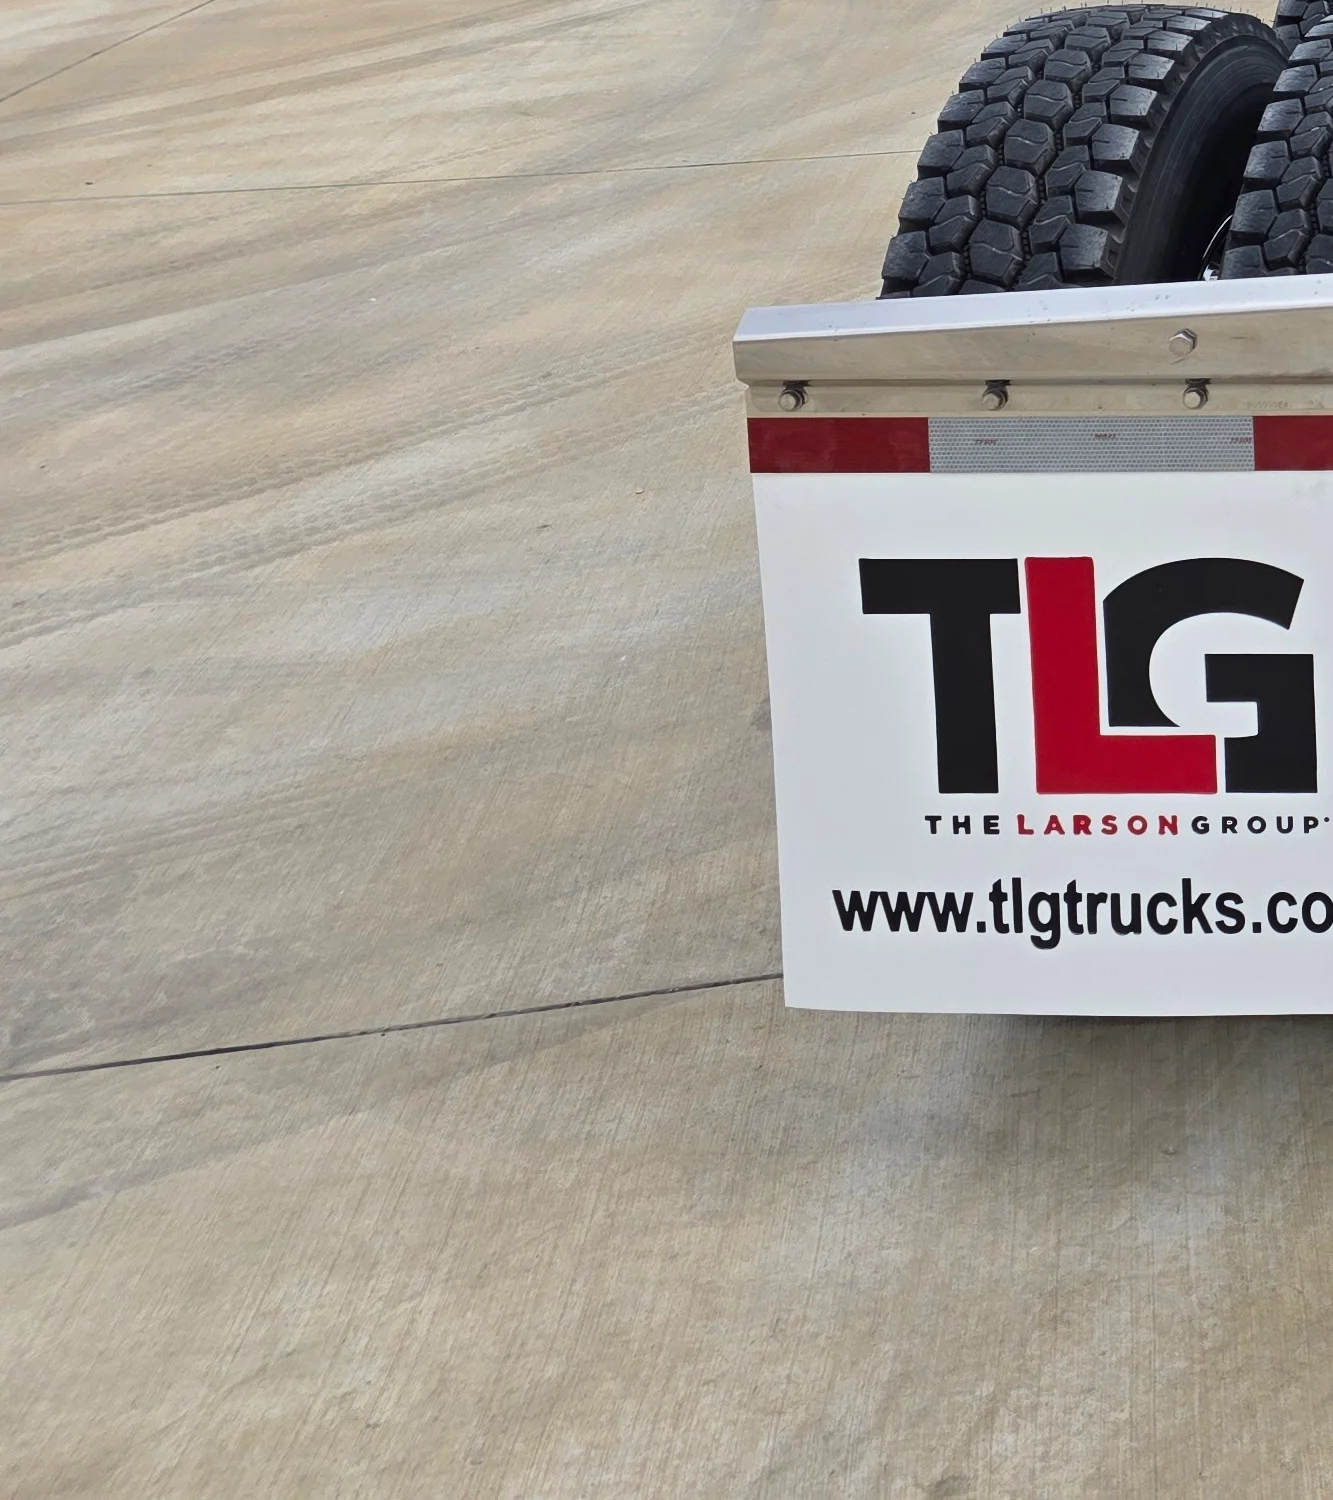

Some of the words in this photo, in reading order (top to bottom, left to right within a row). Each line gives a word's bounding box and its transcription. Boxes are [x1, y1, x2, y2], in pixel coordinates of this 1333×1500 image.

[858, 556, 1318, 795] TLG
[924, 814, 1001, 836] THE
[1016, 814, 1179, 836] LARSON
